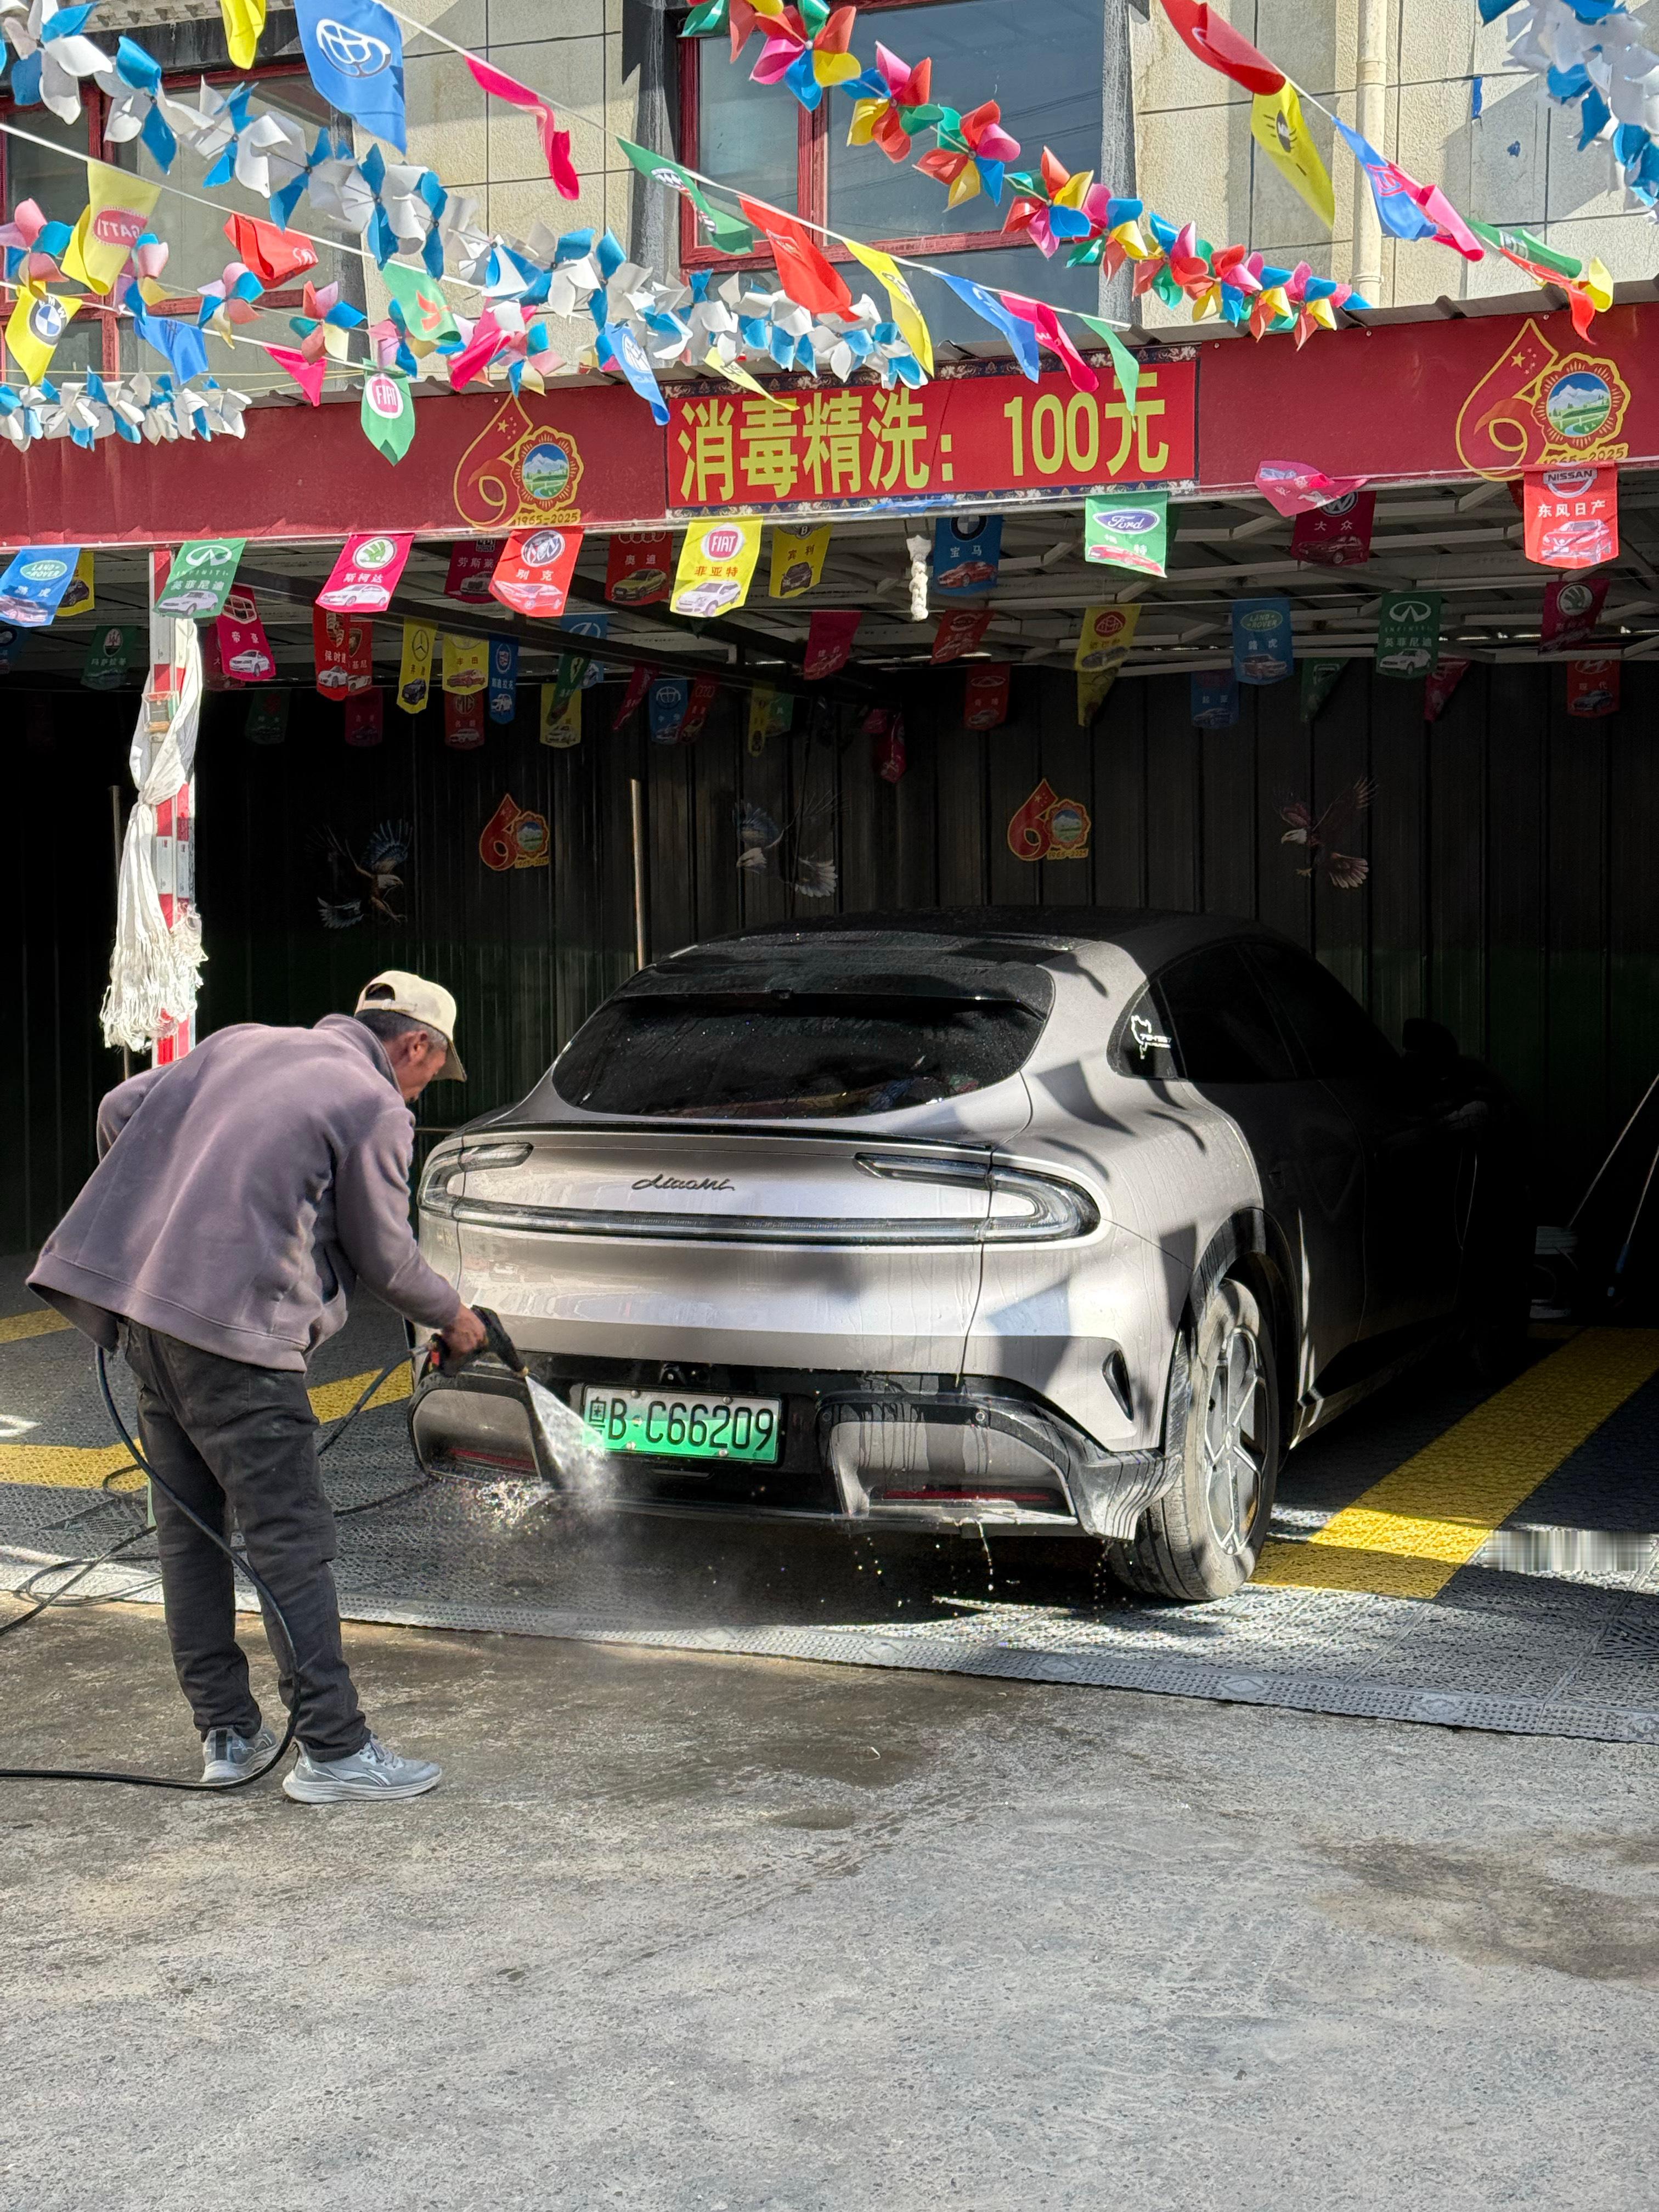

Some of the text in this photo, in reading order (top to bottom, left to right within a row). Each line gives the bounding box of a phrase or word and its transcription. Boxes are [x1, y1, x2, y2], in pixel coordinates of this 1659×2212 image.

[375, 385, 398, 407] FIAT
[1004, 373, 1169, 477] 100元
[1548, 470, 1593, 482] NISSAN
[1538, 499, 1606, 518] 东风日产
[517, 512, 578, 525] 1965-2025
[1107, 515, 1146, 529] Ford
[1313, 520, 1353, 532] 大众
[711, 535, 737, 552] FIAT
[950, 545, 983, 558] 宝马
[456, 556, 494, 569] 劳斯莱
[624, 554, 656, 566] 奥迪
[342, 572, 384, 584] 斯柯达
[516, 568, 554, 581] 别克
[693, 566, 738, 577] 菲亚特
[456, 656, 478, 665] 丰田
